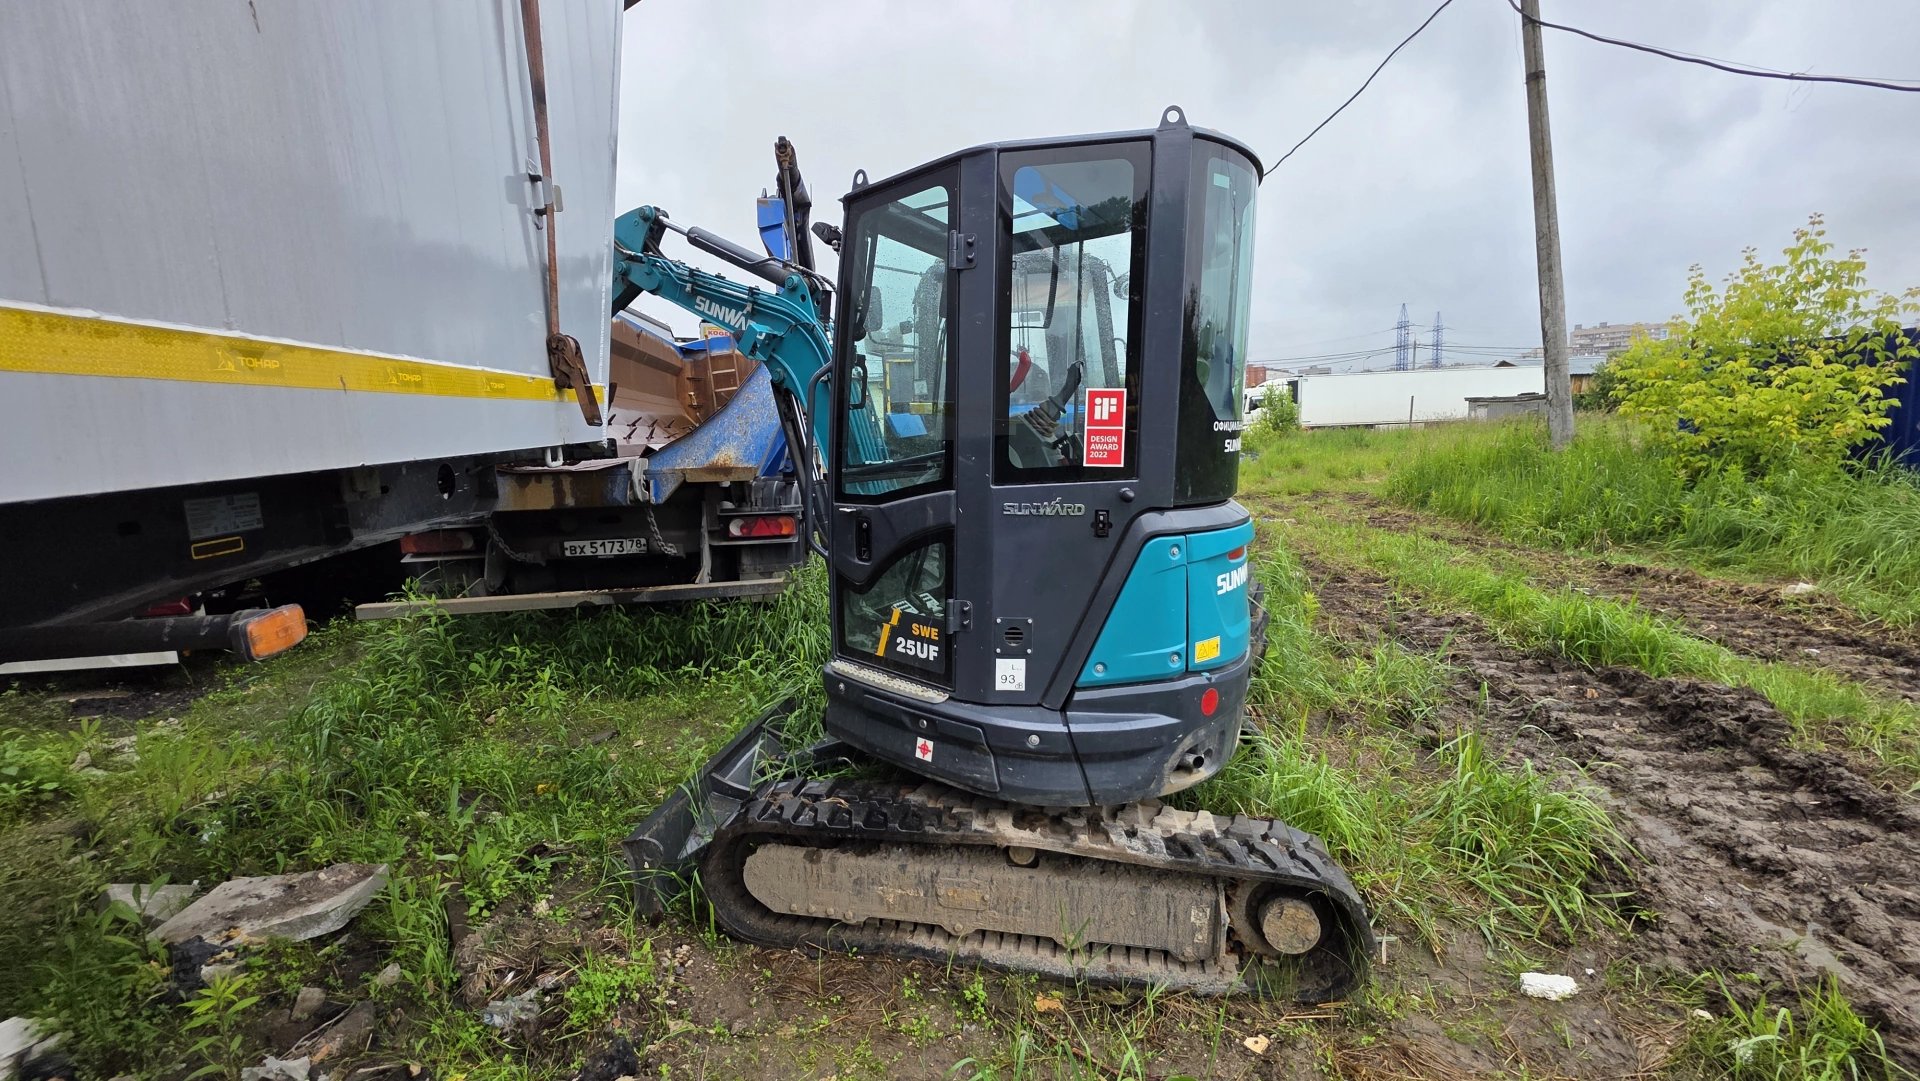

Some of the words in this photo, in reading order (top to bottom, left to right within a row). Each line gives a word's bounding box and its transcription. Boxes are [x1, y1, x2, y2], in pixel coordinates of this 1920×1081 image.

[1094, 397, 1117, 420] iF
[1089, 443, 1119, 451] AWARD
[1090, 435, 1118, 443] DESIGN
[1003, 497, 1086, 516] SUNWARD
[590, 541, 624, 554] 5173
[628, 539, 642, 549] 78
[911, 622, 939, 640] SWE
[896, 636, 939, 661] 25UF
[1000, 675, 1015, 684] 93
